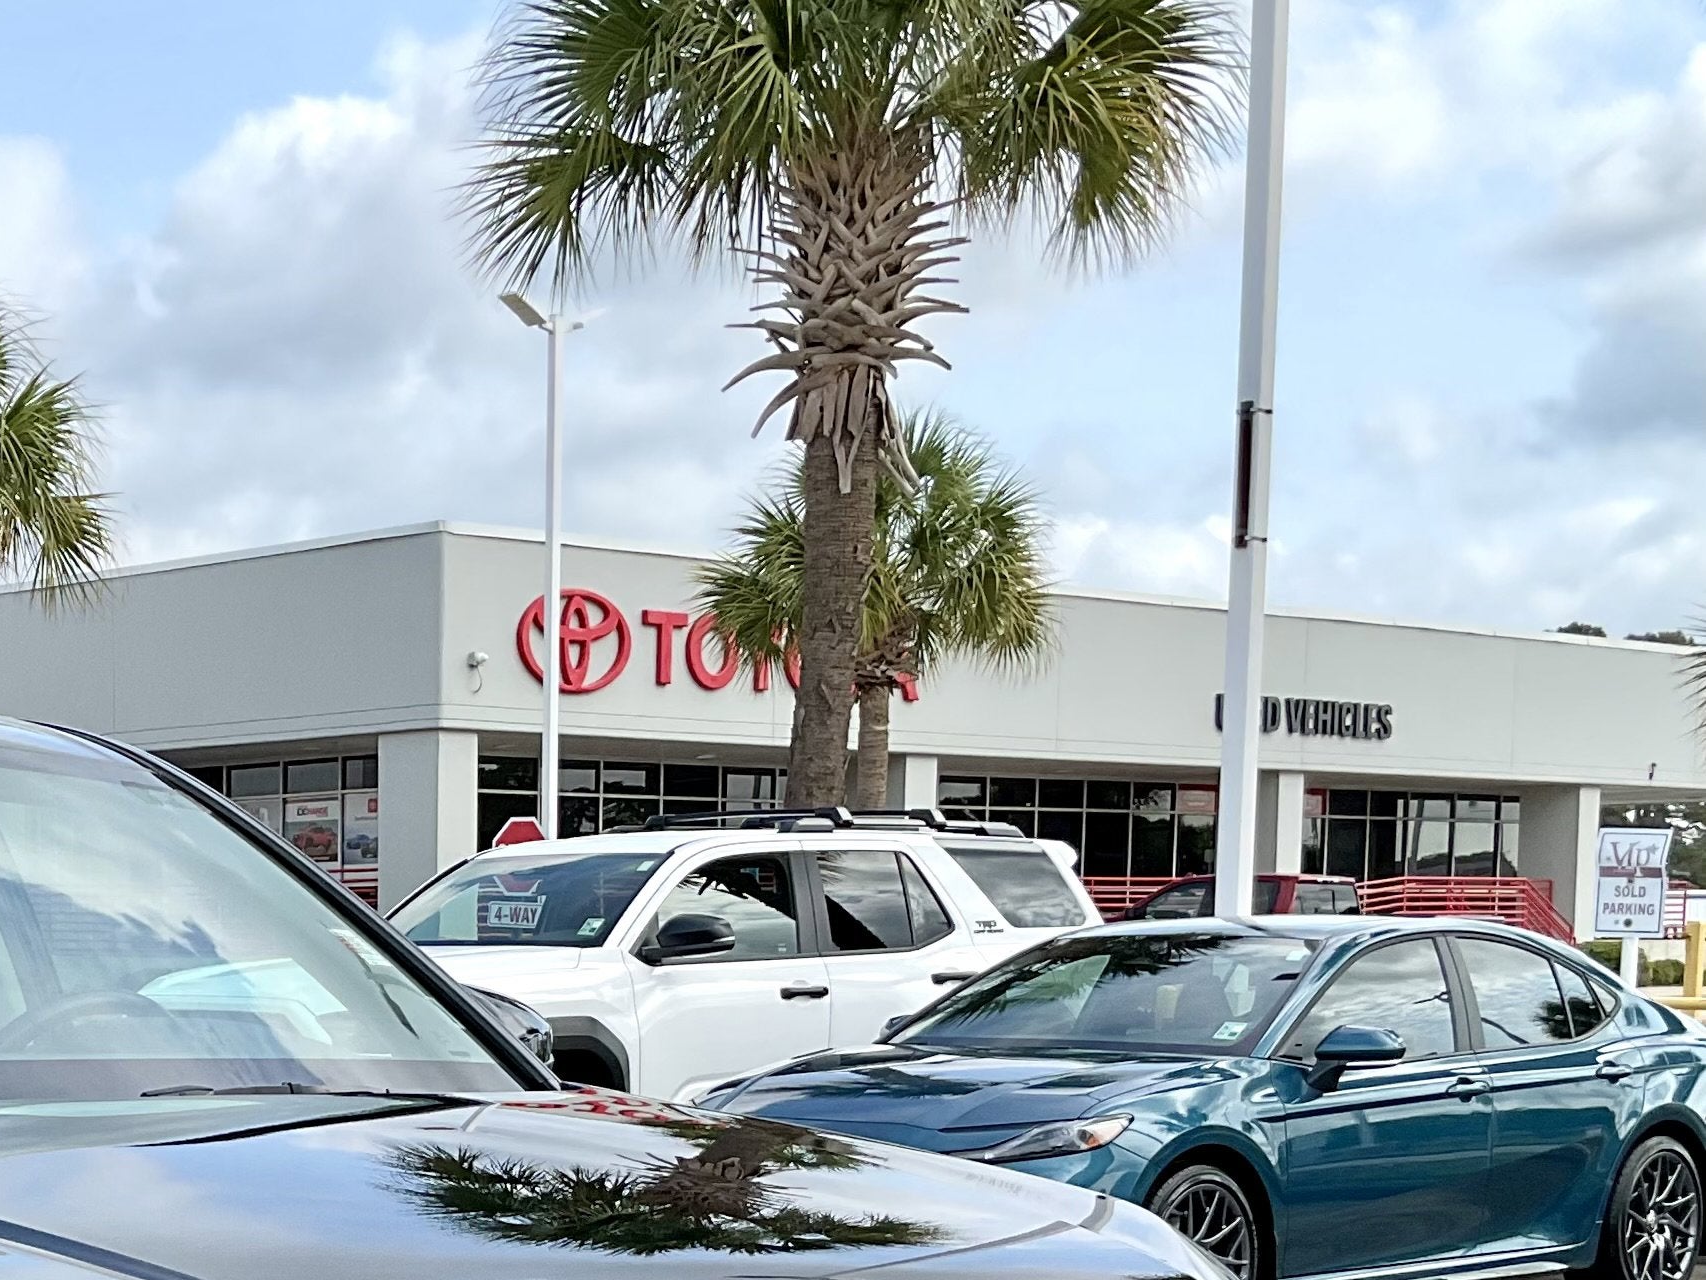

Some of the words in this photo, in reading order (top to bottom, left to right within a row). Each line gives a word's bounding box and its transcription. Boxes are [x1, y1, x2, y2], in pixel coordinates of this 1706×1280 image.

[1284, 697, 1393, 740] VEHICLES
[1614, 885, 1647, 898] SOLD
[494, 906, 538, 924] 4-WAY
[1602, 902, 1655, 916] PARKING
